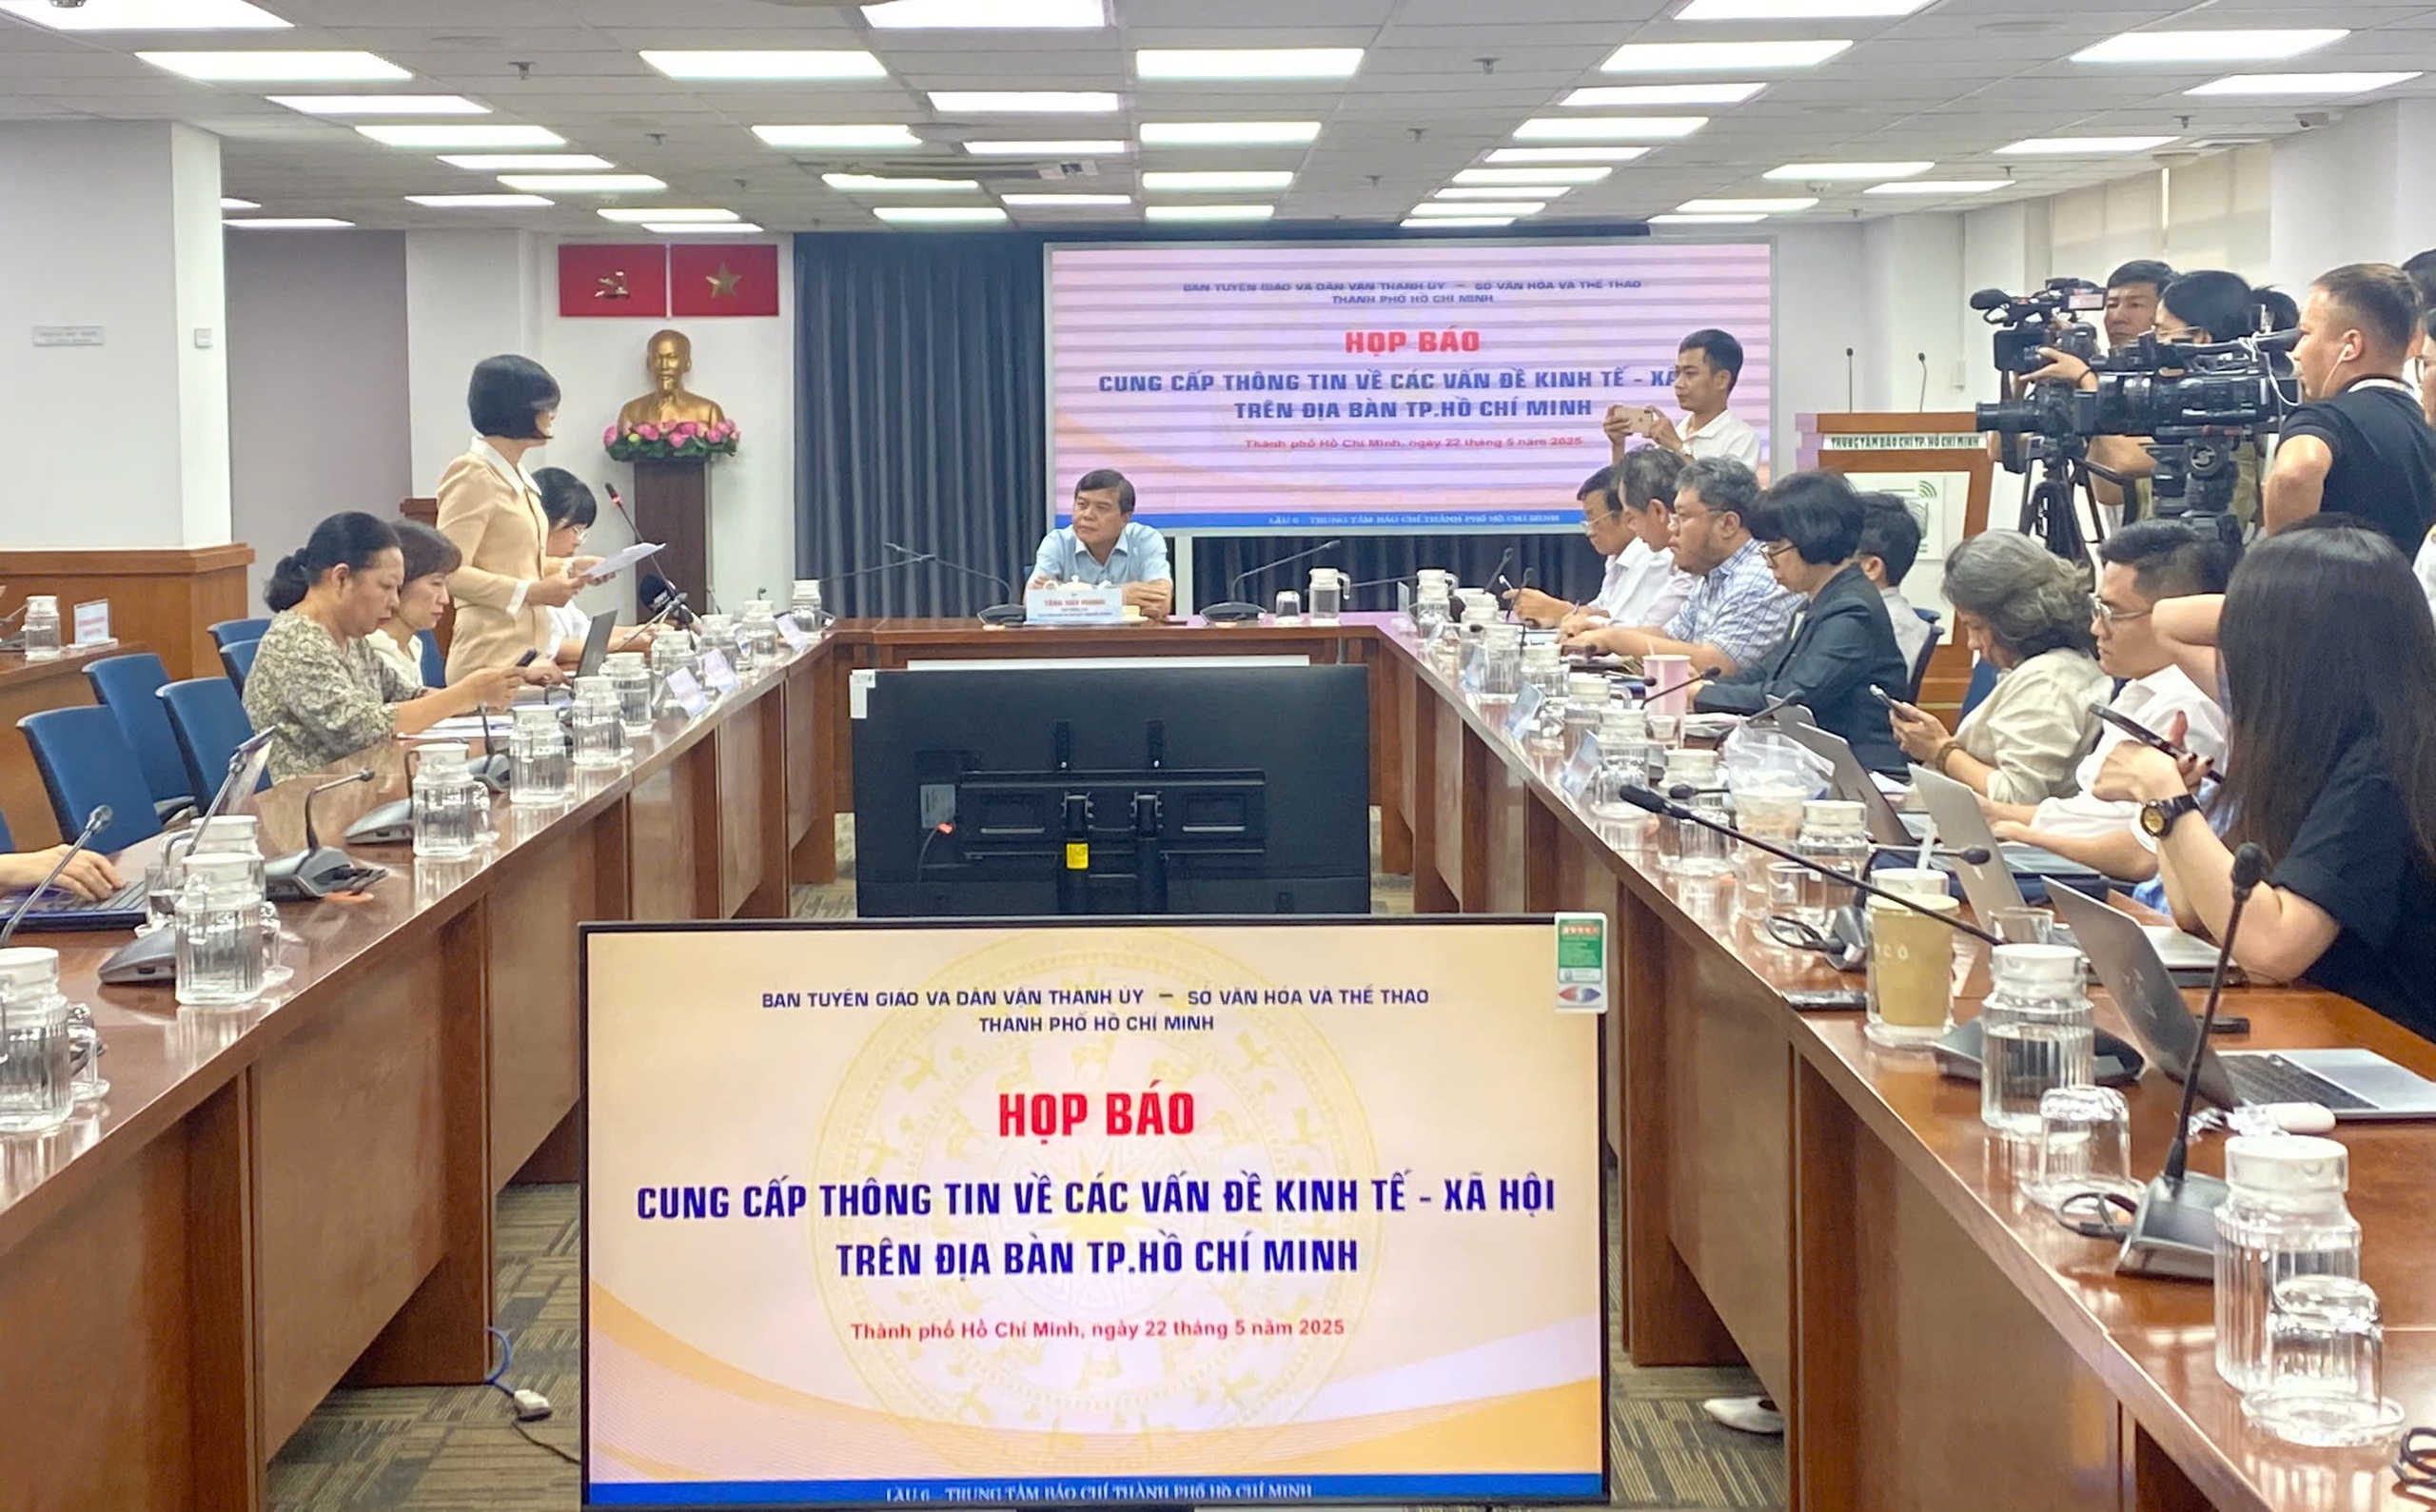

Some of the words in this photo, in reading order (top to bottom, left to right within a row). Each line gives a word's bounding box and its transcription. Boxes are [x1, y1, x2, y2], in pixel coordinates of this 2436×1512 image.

[1459, 294, 1494, 304] MINH
[1345, 331, 1406, 357] HỌP
[1418, 324, 1480, 353] BÁO
[1099, 375, 1162, 392] CUNG
[1170, 370, 1214, 391] CẤP
[1223, 371, 1299, 391] THÔNG
[1307, 373, 1346, 391] TIN
[1355, 368, 1382, 390] VỀ
[1390, 367, 1435, 390] CÁC
[1443, 367, 1490, 389] VẤN
[1500, 366, 1526, 389] ĐỀ
[1535, 370, 1592, 388] KINH
[1601, 365, 1628, 387] TẾ
[1234, 400, 1292, 419] TRÊN
[1302, 402, 1340, 421] ĐỊA
[1348, 398, 1397, 419] BÀN
[1405, 396, 1471, 418] TP.HỒ
[1479, 396, 1519, 417] CHÍ
[1526, 399, 1592, 417] MINH
[1445, 438, 1461, 448] 22
[1550, 436, 1582, 446] 2025
[761, 992, 800, 1009] BAN
[807, 988, 869, 1008] TUYÊN
[875, 987, 919, 1008] GIÁO
[956, 987, 997, 1007] DÂN
[1049, 986, 1112, 1006] THÀNH
[1381, 988, 1429, 1005] THAO
[1050, 1011, 1088, 1032] PHỐ
[1094, 1011, 1120, 1031] HỒ
[1127, 1012, 1157, 1031] CHÍ
[1164, 1014, 1214, 1031] MINH
[999, 1092, 1088, 1145] HỌP
[1106, 1079, 1194, 1137] BÁO
[638, 1186, 729, 1219] CUNG
[743, 1175, 807, 1218] CẤP
[819, 1177, 932, 1217] THÔNG
[945, 1182, 1000, 1216] TIN
[1014, 1171, 1052, 1215] VỀ
[1066, 1171, 1129, 1214] CÁC
[1142, 1169, 1209, 1214] VẤN
[1224, 1169, 1263, 1213] ĐỀ
[1275, 1179, 1358, 1212] KINH
[1371, 1168, 1413, 1212] TẾ
[1443, 1171, 1486, 1212] XÃ
[1500, 1171, 1556, 1218] HỘI
[835, 1237, 920, 1277] TRÊN
[935, 1242, 991, 1282] ĐỊA
[1005, 1232, 1073, 1275] BÀN
[1087, 1229, 1183, 1273] TP.HỒ
[1195, 1230, 1253, 1272] CHÍ
[1264, 1239, 1358, 1272] MINH
[851, 1321, 912, 1340] Thành
[918, 1318, 955, 1343] phố
[961, 1318, 989, 1340] Hồ
[994, 1319, 1027, 1339] Chí
[1032, 1320, 1086, 1341] Minh,
[1091, 1320, 1139, 1343] ngày
[1145, 1320, 1167, 1338] 22
[1173, 1319, 1228, 1342] tháng
[1234, 1319, 1246, 1336] 5
[1252, 1319, 1293, 1337] năm
[1299, 1318, 1346, 1337] 2025
[945, 1486, 1002, 1502] TRUNG
[1005, 1483, 1039, 1502] TÂM
[1045, 1482, 1076, 1501] BÁO
[1080, 1481, 1110, 1501] CHÍ
[1112, 1482, 1169, 1501] THÀNH
[1174, 1481, 1206, 1500] PHỐ
[1209, 1482, 1231, 1500] HỒ
[1235, 1480, 1265, 1500] CHÍ
[1267, 1483, 1312, 1500] MINH
